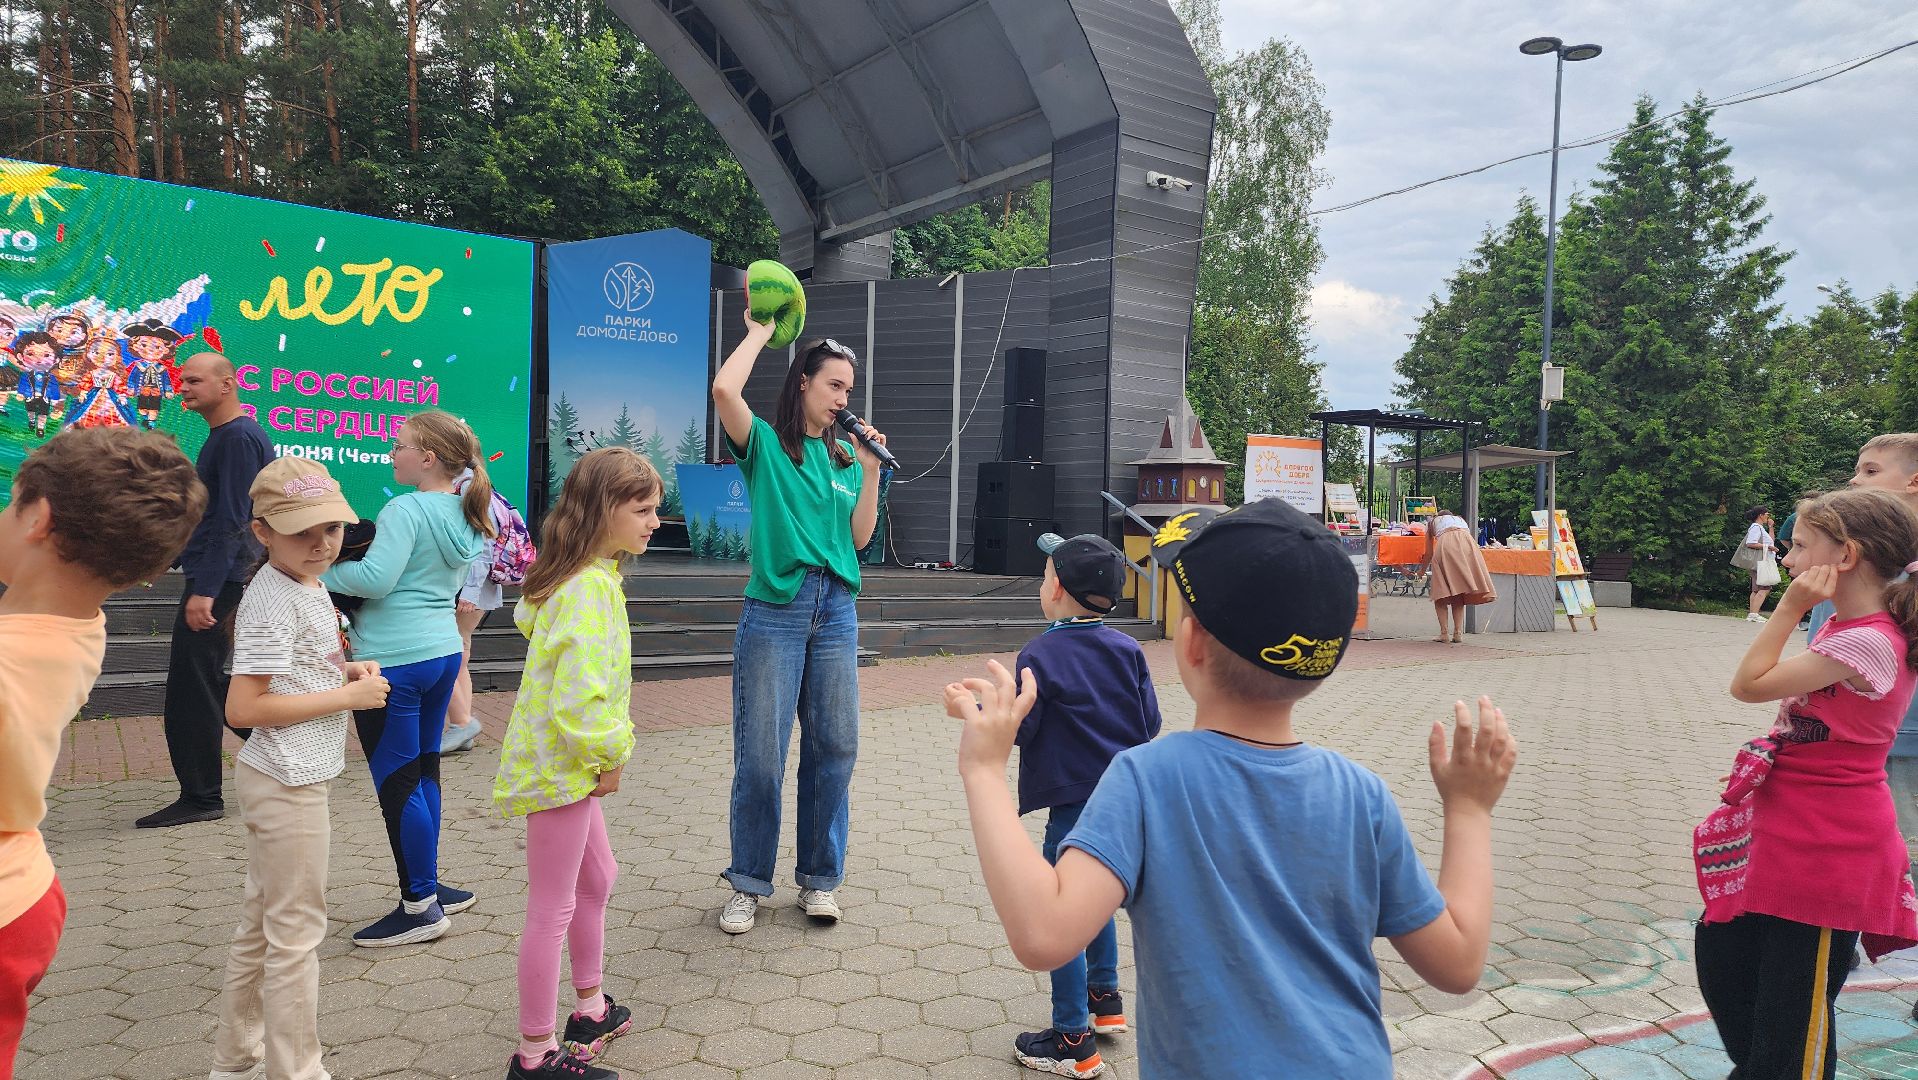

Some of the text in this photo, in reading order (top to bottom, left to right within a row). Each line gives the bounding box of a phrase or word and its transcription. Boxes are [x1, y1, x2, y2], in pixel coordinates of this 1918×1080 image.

[605, 314, 651, 328] ПАРКИ
[576, 325, 678, 344] ДОМОДЕДОВО
[235, 364, 439, 405] С РОССИЕЙ
